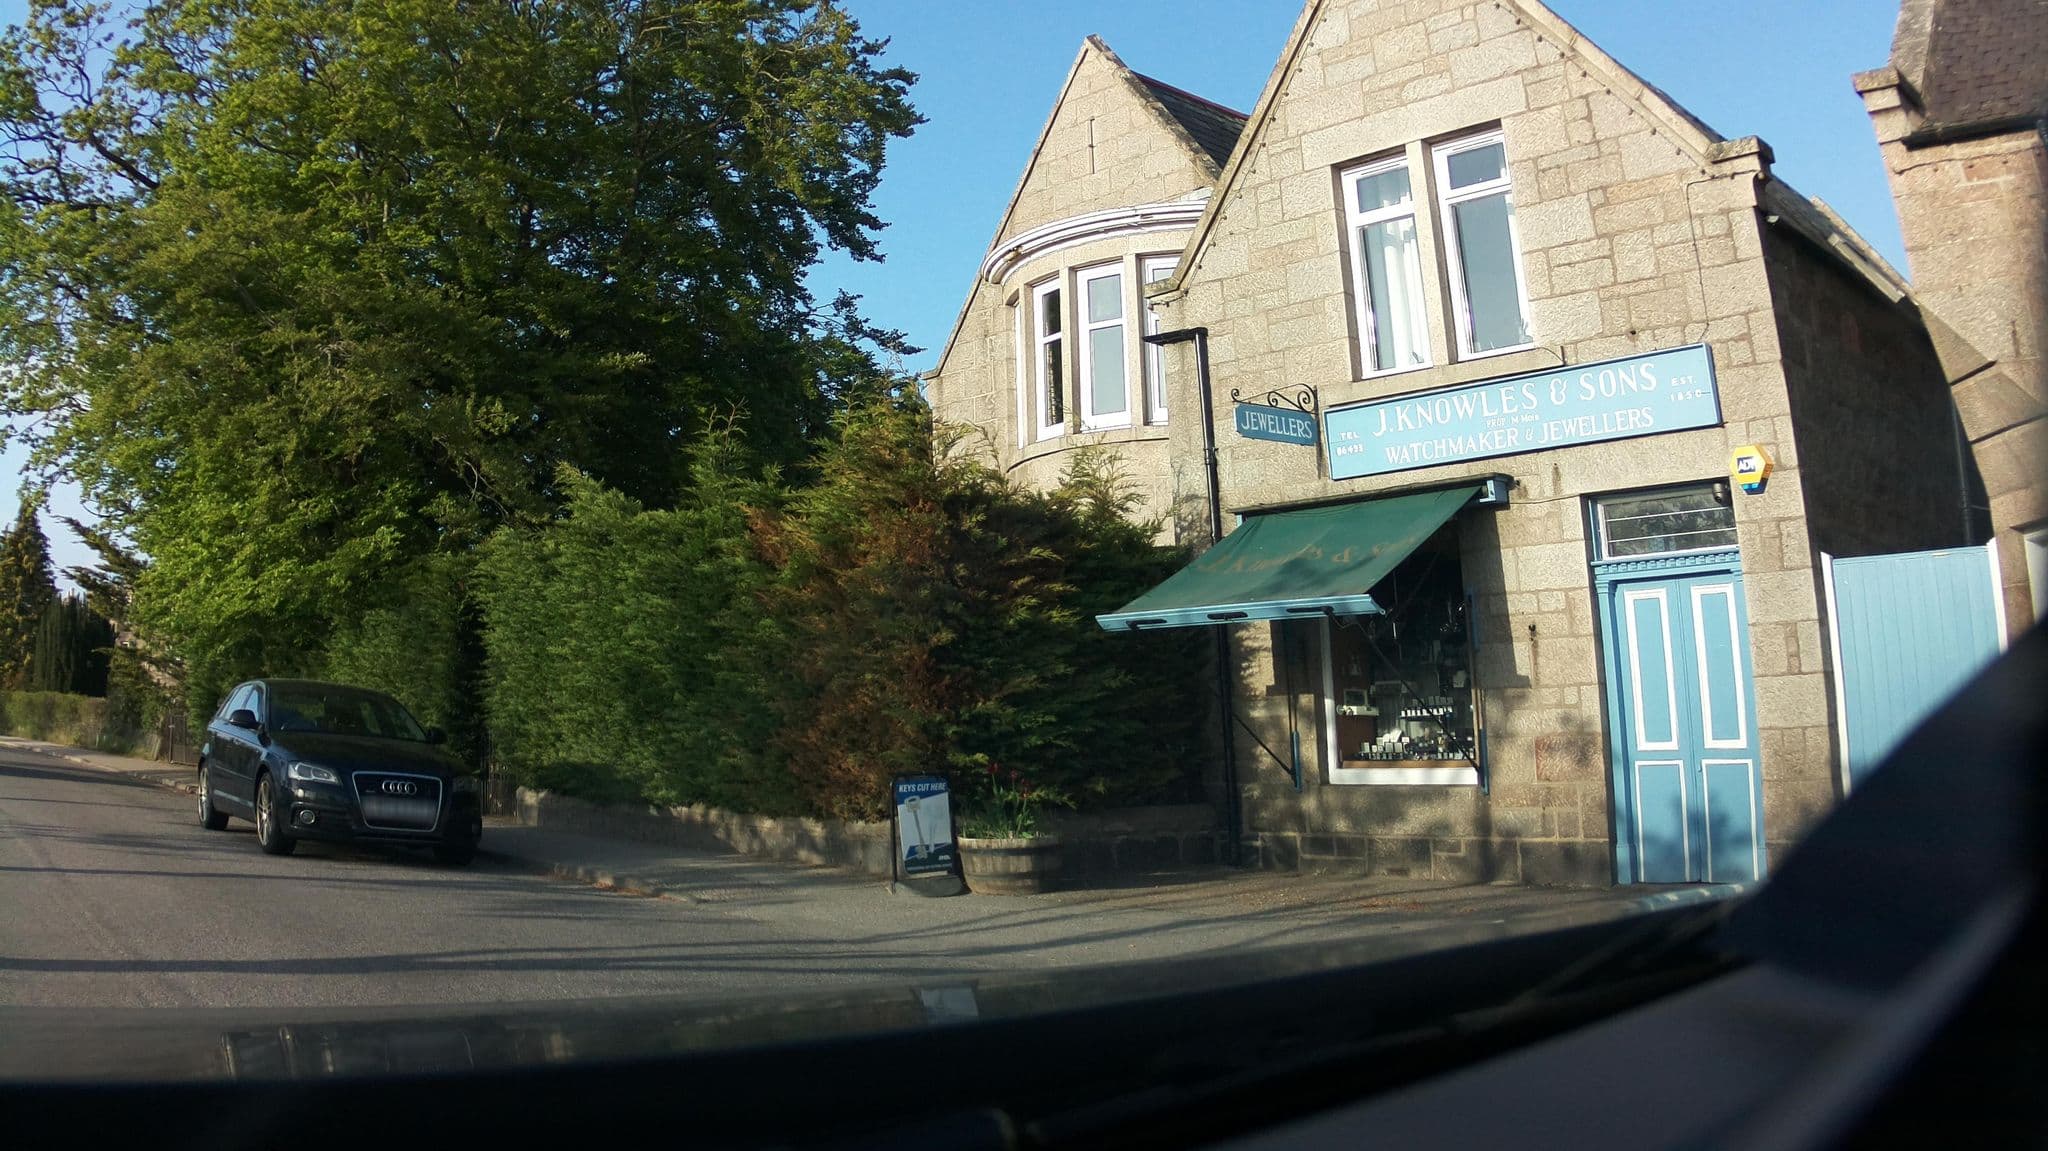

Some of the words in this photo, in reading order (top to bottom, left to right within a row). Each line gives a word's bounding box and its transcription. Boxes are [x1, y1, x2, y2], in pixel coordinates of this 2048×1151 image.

[1550, 378, 1568, 405] &
[1579, 363, 1657, 401] SONS
[1241, 411, 1313, 439] JEWELLERS
[1339, 431, 1361, 441] TEL
[1385, 427, 1520, 464] WATCHMAKER
[1525, 427, 1534, 441] &
[1538, 407, 1654, 444] JEWELLERS
[898, 783, 917, 793] KEYS
[917, 783, 930, 792] CUT
[930, 782, 947, 791] HERE
